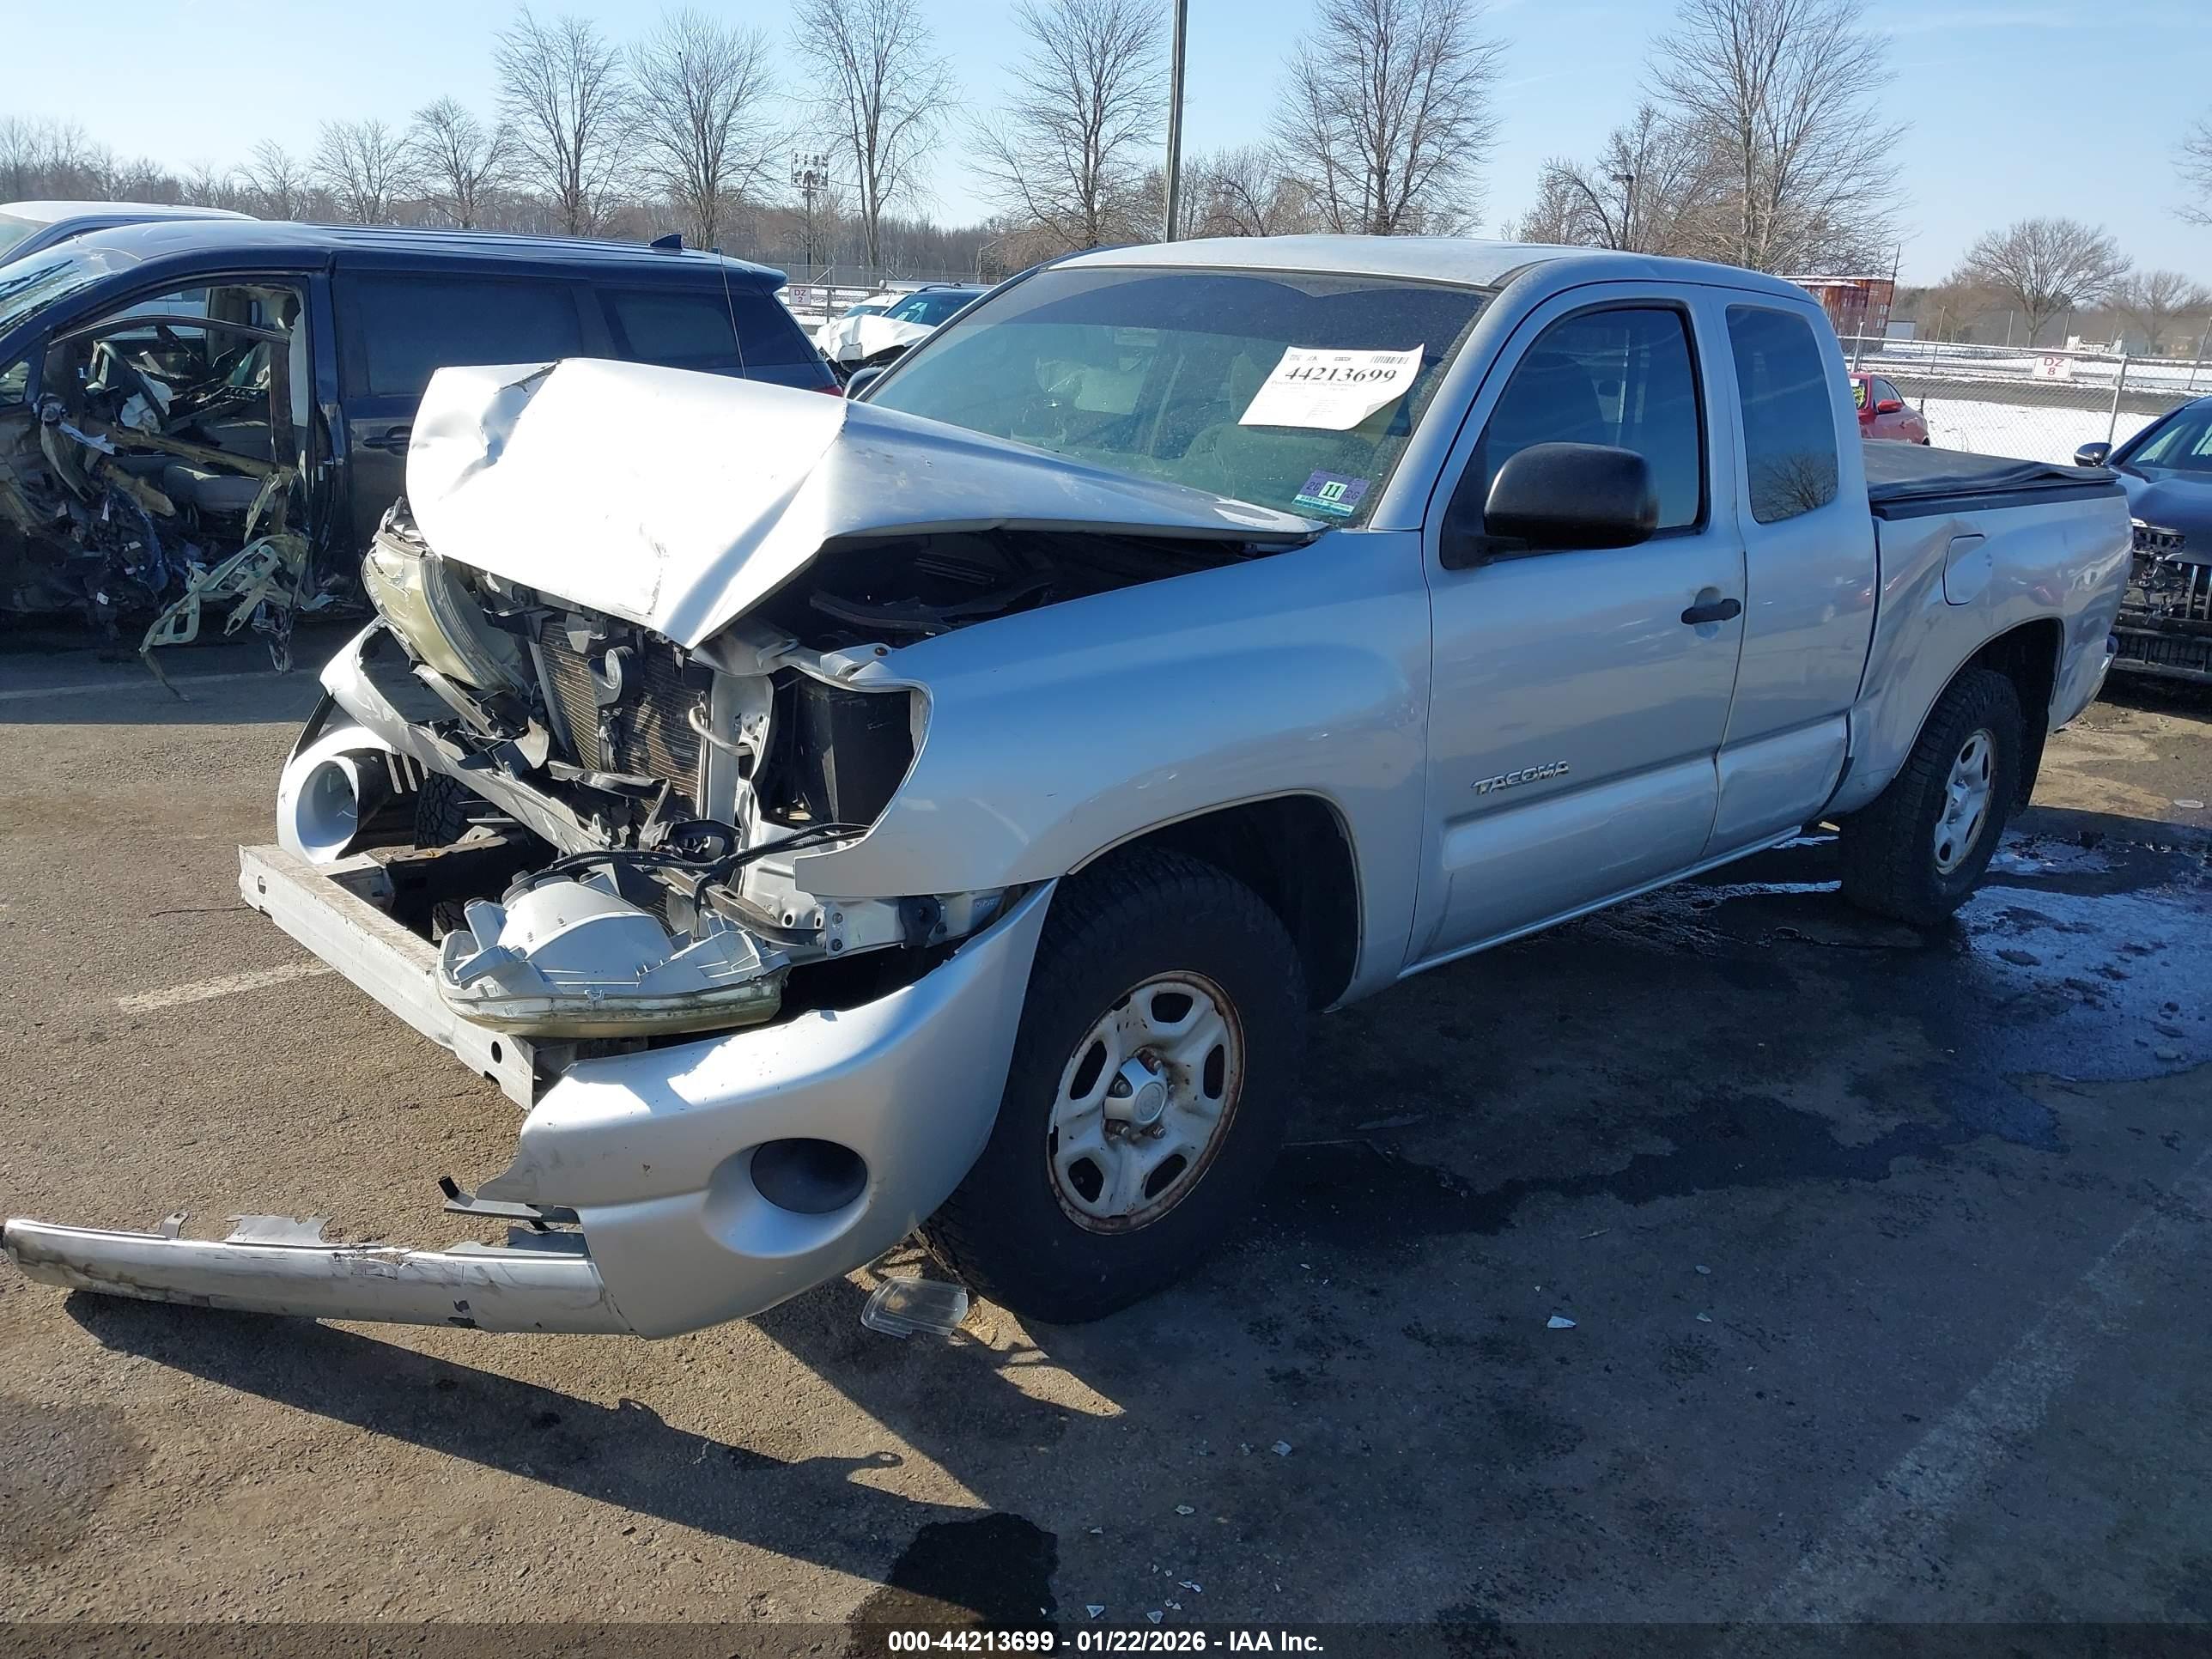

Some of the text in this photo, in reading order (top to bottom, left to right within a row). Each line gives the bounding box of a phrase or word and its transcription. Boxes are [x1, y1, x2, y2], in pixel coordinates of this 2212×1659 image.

[2044, 357, 2064, 368] DZ
[1285, 367, 1397, 384] 44213699
[2047, 368, 2056, 376] 8
[1322, 483, 1341, 498] 11
[1470, 761, 1569, 794] TACOMA
